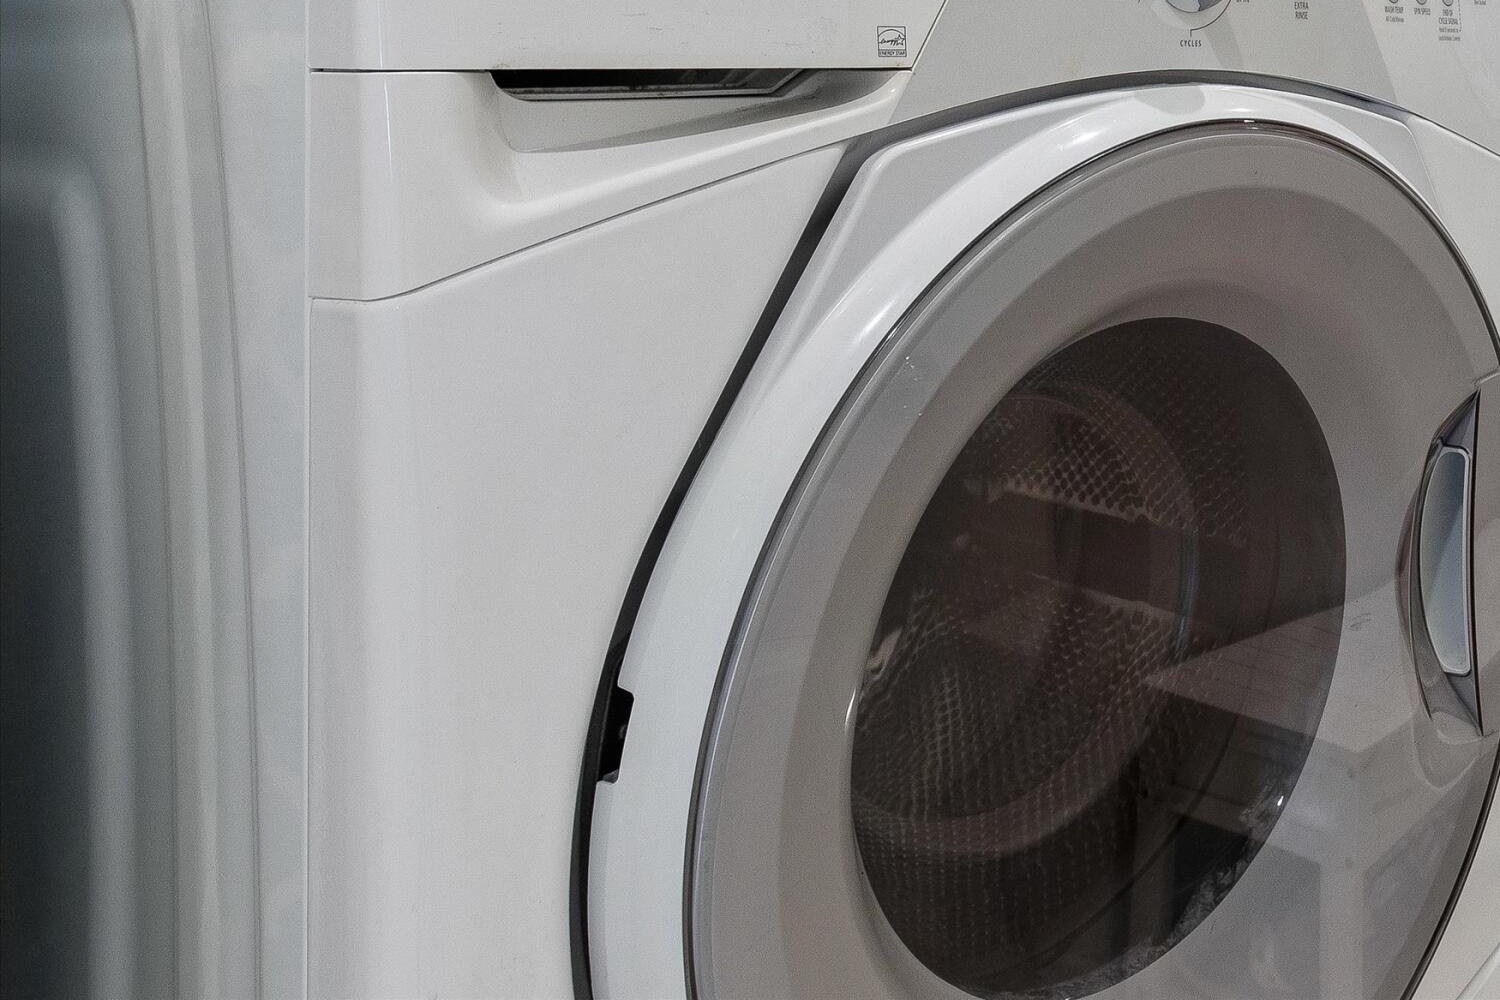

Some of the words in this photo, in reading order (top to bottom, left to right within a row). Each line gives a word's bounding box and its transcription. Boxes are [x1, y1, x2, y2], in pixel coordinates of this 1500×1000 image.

[1294, 1, 1309, 10] EXTRA
[1295, 11, 1309, 20] RINSE
[1180, 39, 1202, 47] CYCLES
